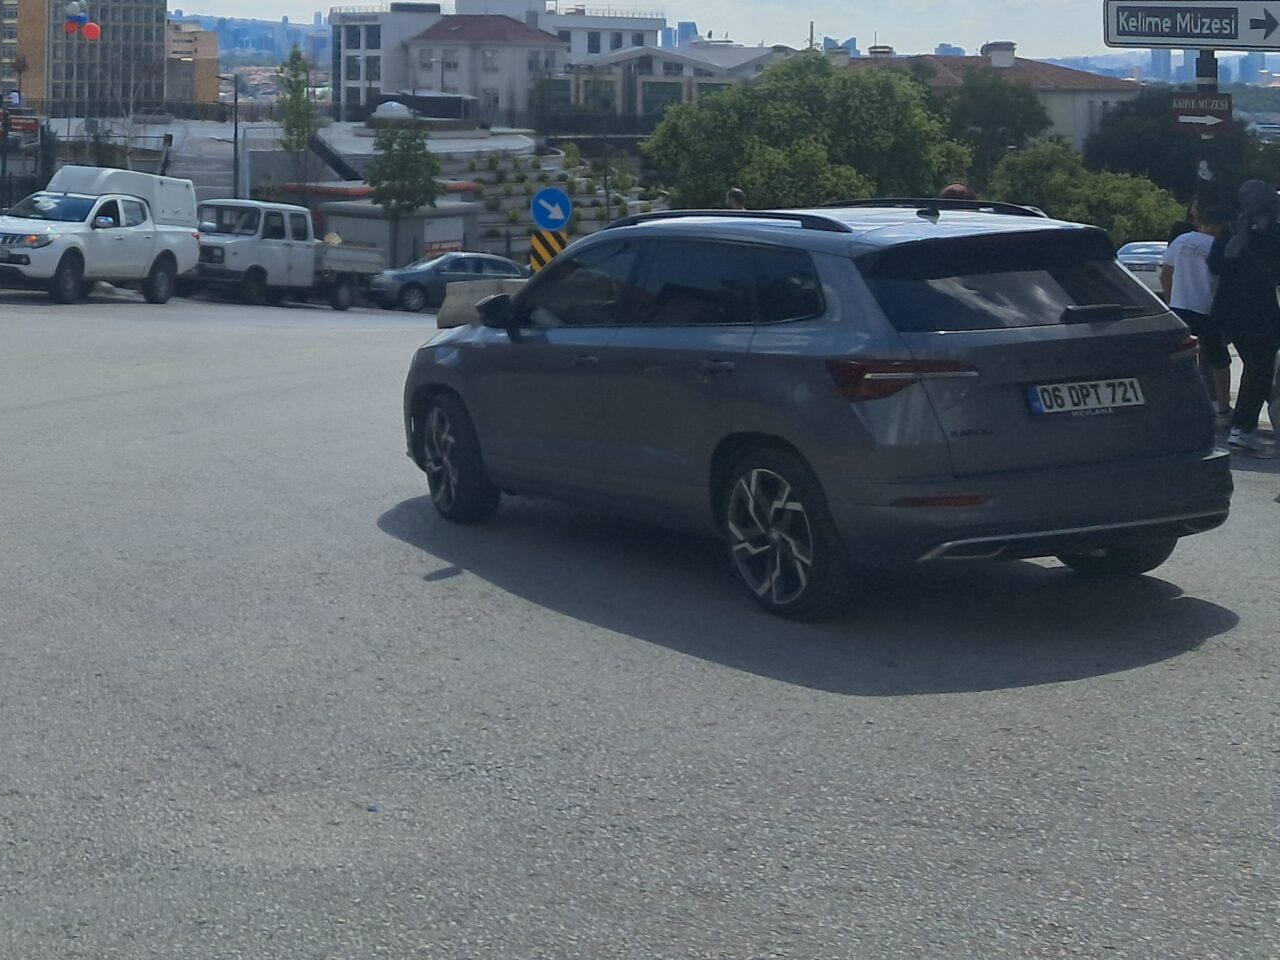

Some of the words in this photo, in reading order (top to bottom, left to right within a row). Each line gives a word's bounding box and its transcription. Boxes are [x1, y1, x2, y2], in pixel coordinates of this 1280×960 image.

[1119, 11, 1172, 33] Kelime
[1176, 12, 1235, 34] Müzesi
[1040, 387, 1065, 409] 06
[1068, 383, 1102, 407] DPT
[1105, 380, 1140, 404] 721
